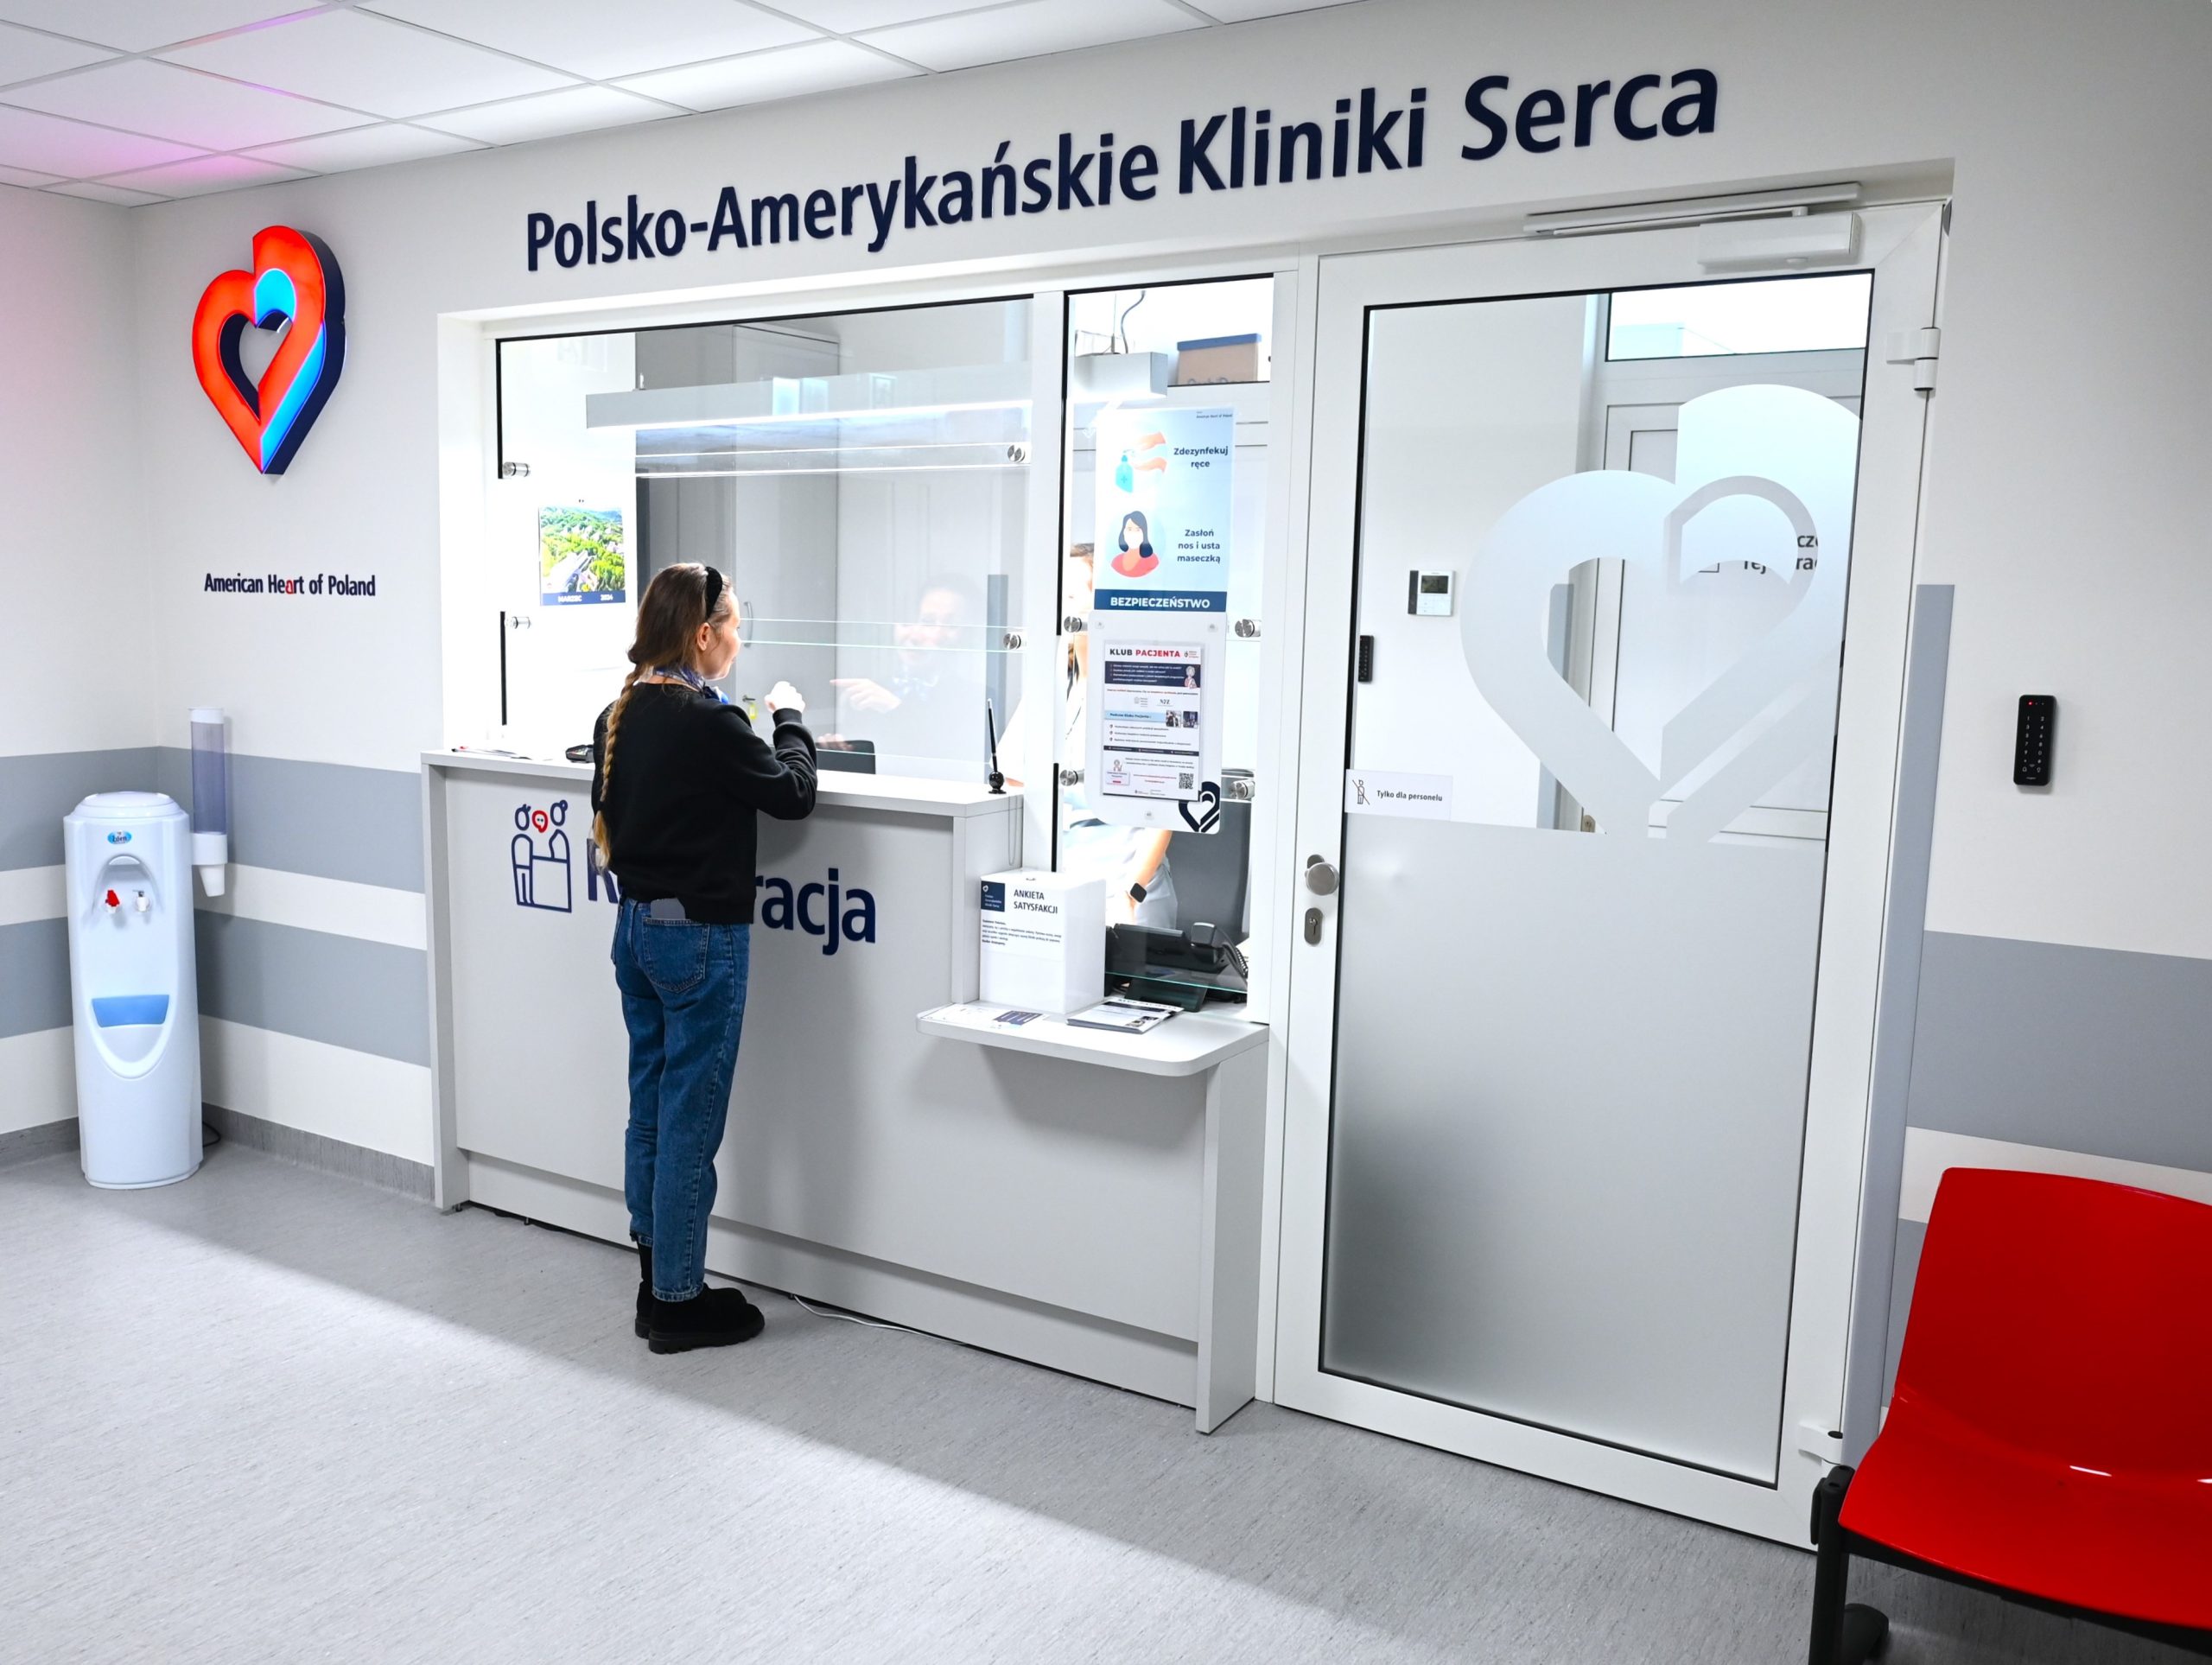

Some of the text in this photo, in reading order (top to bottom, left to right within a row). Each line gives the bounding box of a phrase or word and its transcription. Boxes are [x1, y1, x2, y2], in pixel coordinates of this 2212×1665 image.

[527, 67, 1719, 272] Polsko-Amerykańskie Kliniki Serca
[1173, 446, 1229, 456] Zdezynfekuj
[1191, 461, 1211, 470] ręce
[1185, 529, 1214, 537] Zasłoń
[1177, 555, 1221, 564] maseczką
[204, 573, 376, 596] American Heart of Poland
[1109, 596, 1211, 609] BEZPIECZEŃSTWO
[1135, 649, 1181, 658] PACJENTA
[1376, 790, 1443, 802] Tylko dla personelu
[1014, 889, 1045, 900] ANKIETA
[1014, 901, 1058, 914] SATYSFAKCJI
